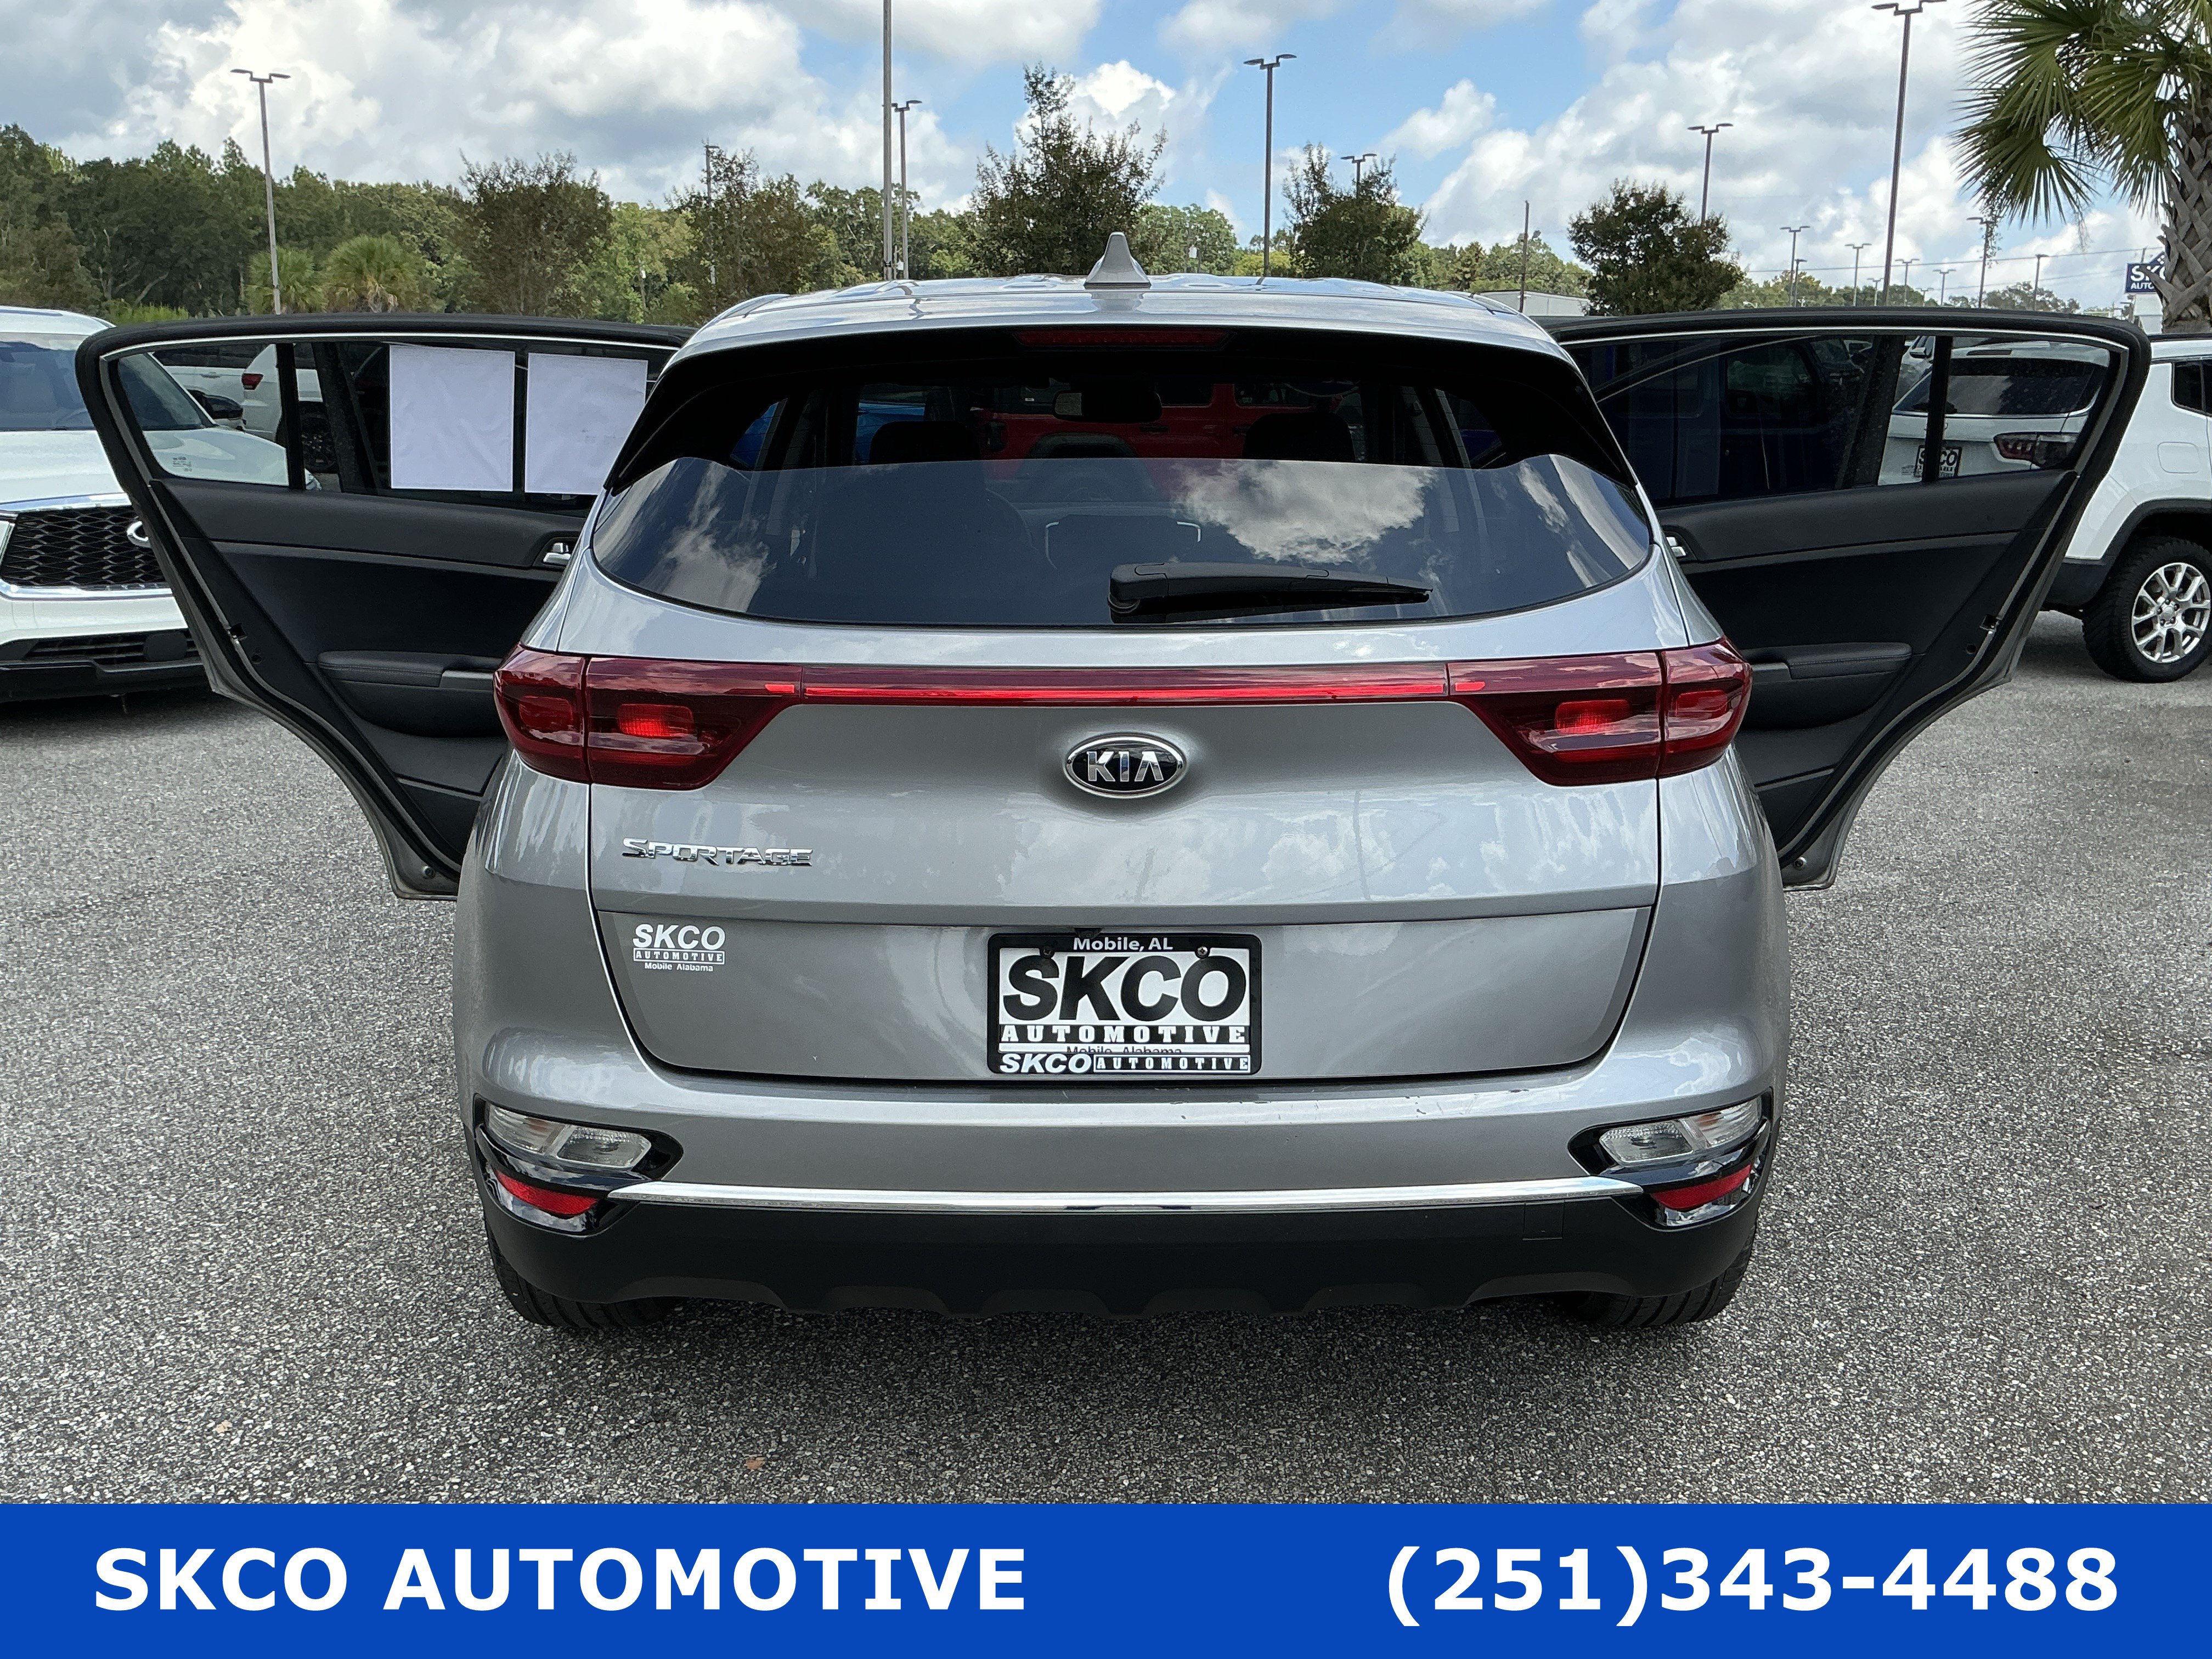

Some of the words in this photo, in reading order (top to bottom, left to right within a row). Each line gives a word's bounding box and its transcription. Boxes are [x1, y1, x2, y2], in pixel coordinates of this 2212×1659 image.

[1086, 751, 1164, 782] KIA
[622, 838, 814, 866] SPORTAGE
[633, 923, 725, 950] SKCO
[1073, 937, 1144, 952] Mobile,
[1148, 938, 1173, 950] AL
[635, 950, 723, 962] AUTOMOTIVE
[644, 962, 673, 970] Mobile
[676, 963, 714, 972] Alabama
[1003, 955, 1246, 1022] SKCO
[1001, 1025, 1245, 1043] AUTOMOTIVE
[1000, 1053, 1092, 1073] SKCO
[1097, 1057, 1249, 1070] AUTOMOTIVE
